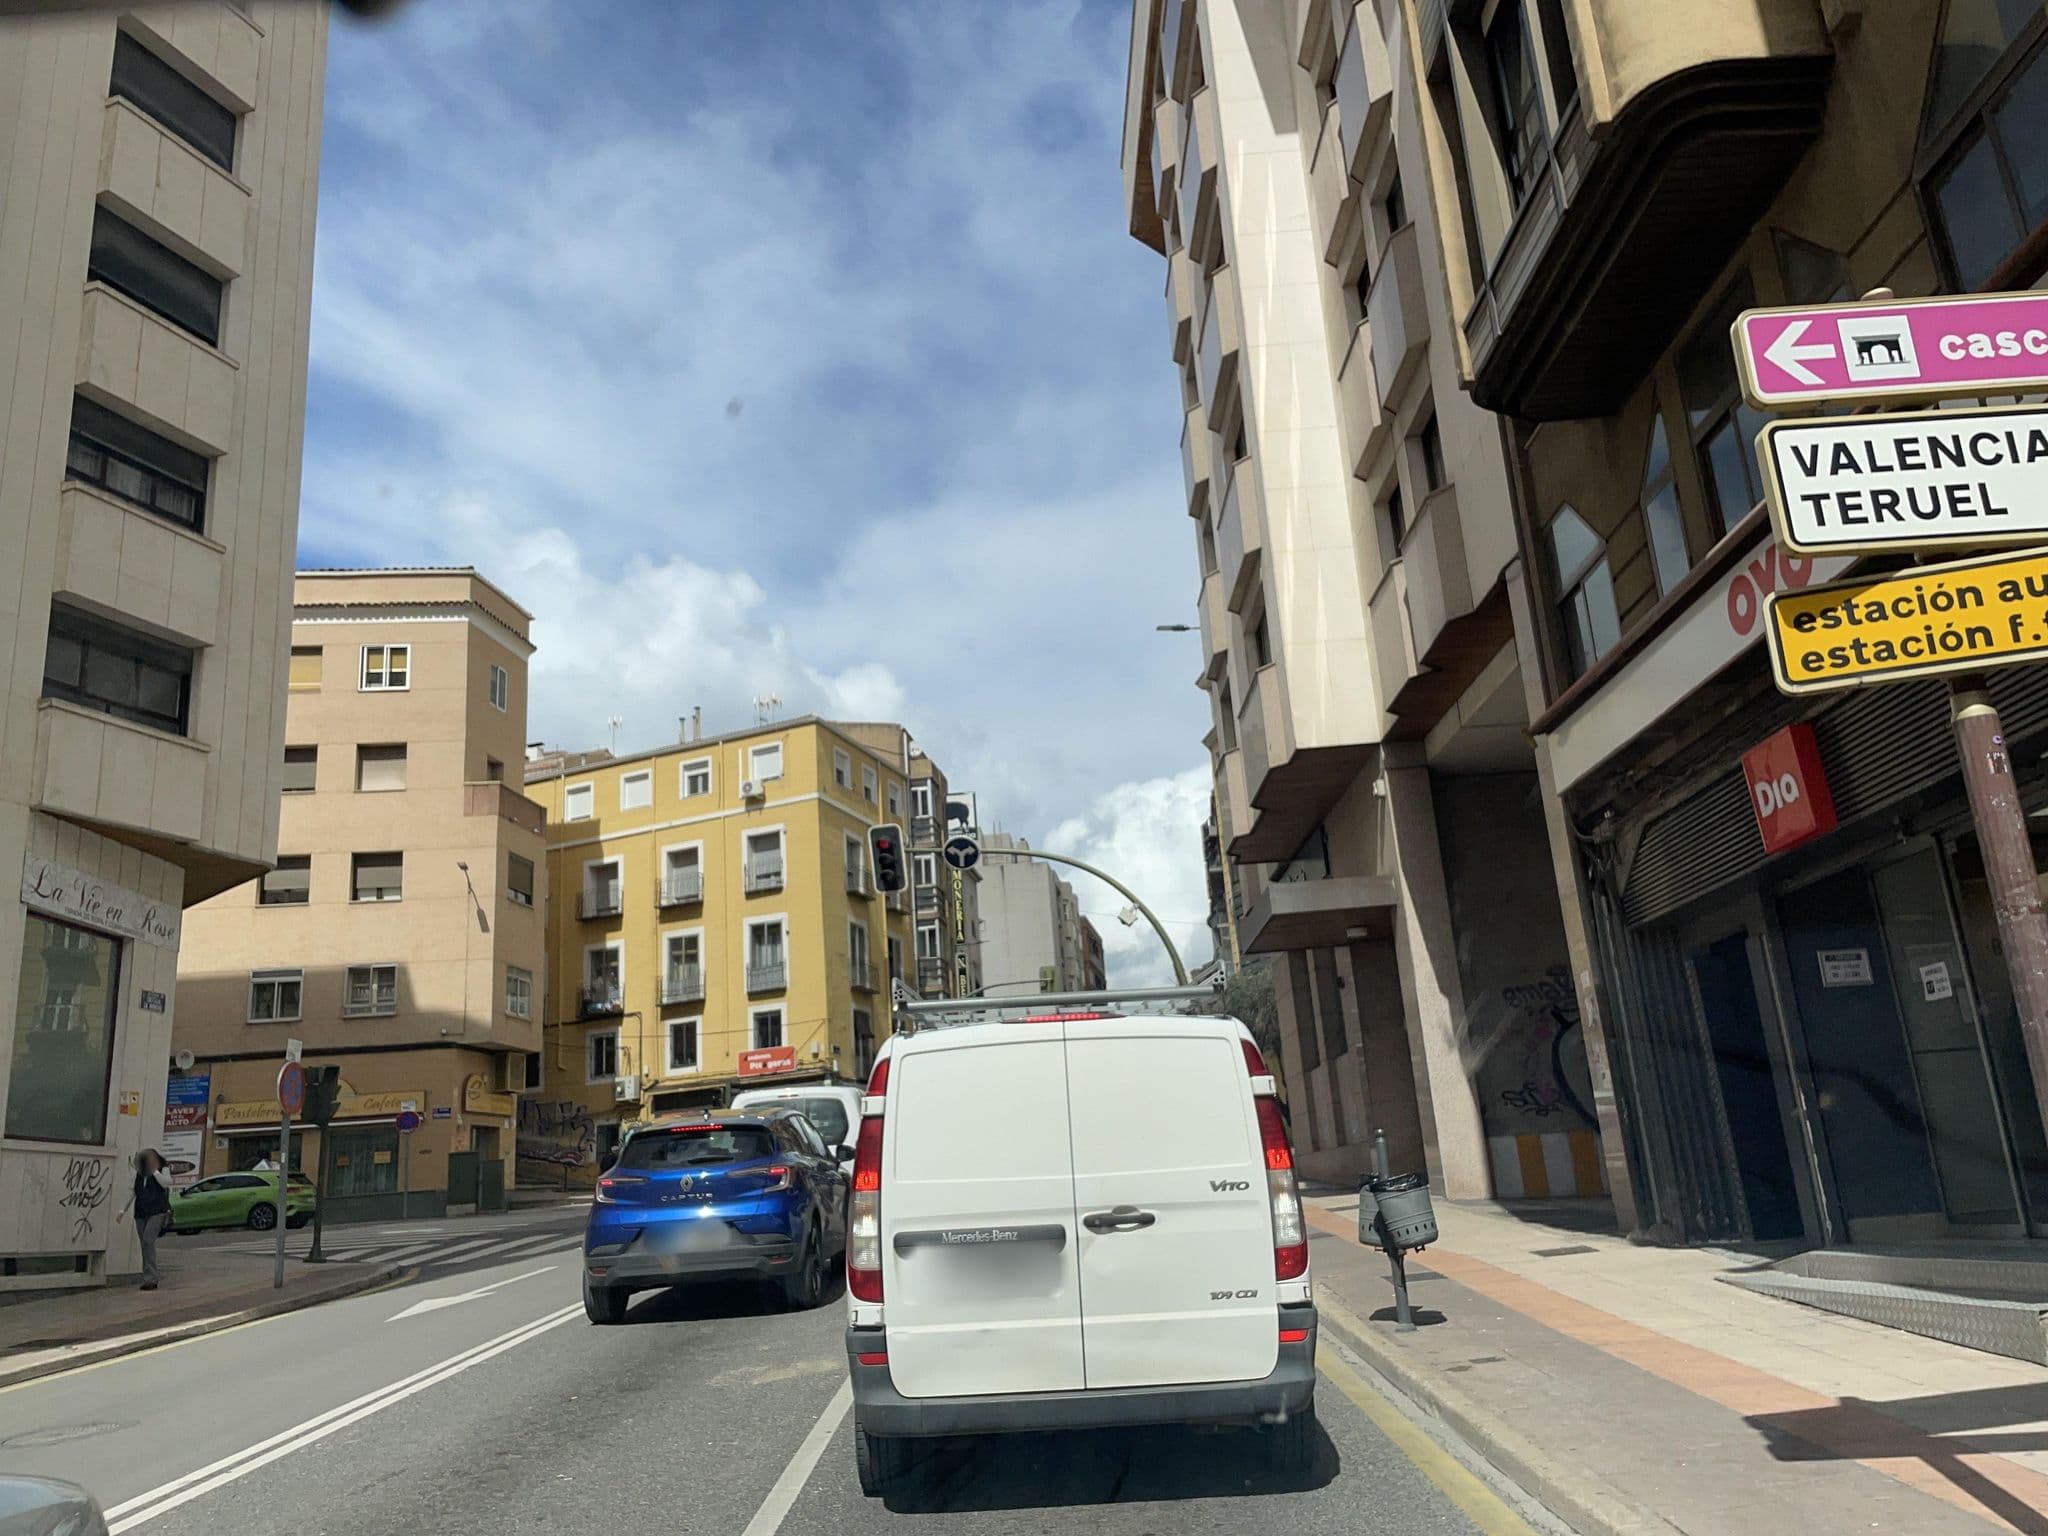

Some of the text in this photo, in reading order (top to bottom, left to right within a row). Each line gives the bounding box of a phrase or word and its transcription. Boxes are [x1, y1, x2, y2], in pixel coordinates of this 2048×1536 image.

[1939, 328, 2048, 360] casc
[1790, 429, 2048, 478] VALENCIA
[1800, 482, 2008, 527] TERUEL
[1793, 573, 2048, 633] estación au
[1800, 624, 1994, 673] estación
[31, 863, 64, 901] La
[73, 878, 102, 914] Vie
[105, 906, 123, 922] en
[140, 907, 176, 939] Rose
[941, 1229, 1019, 1244] Mercedes-Benz
[1210, 1289, 1258, 1300] 109 CDI
